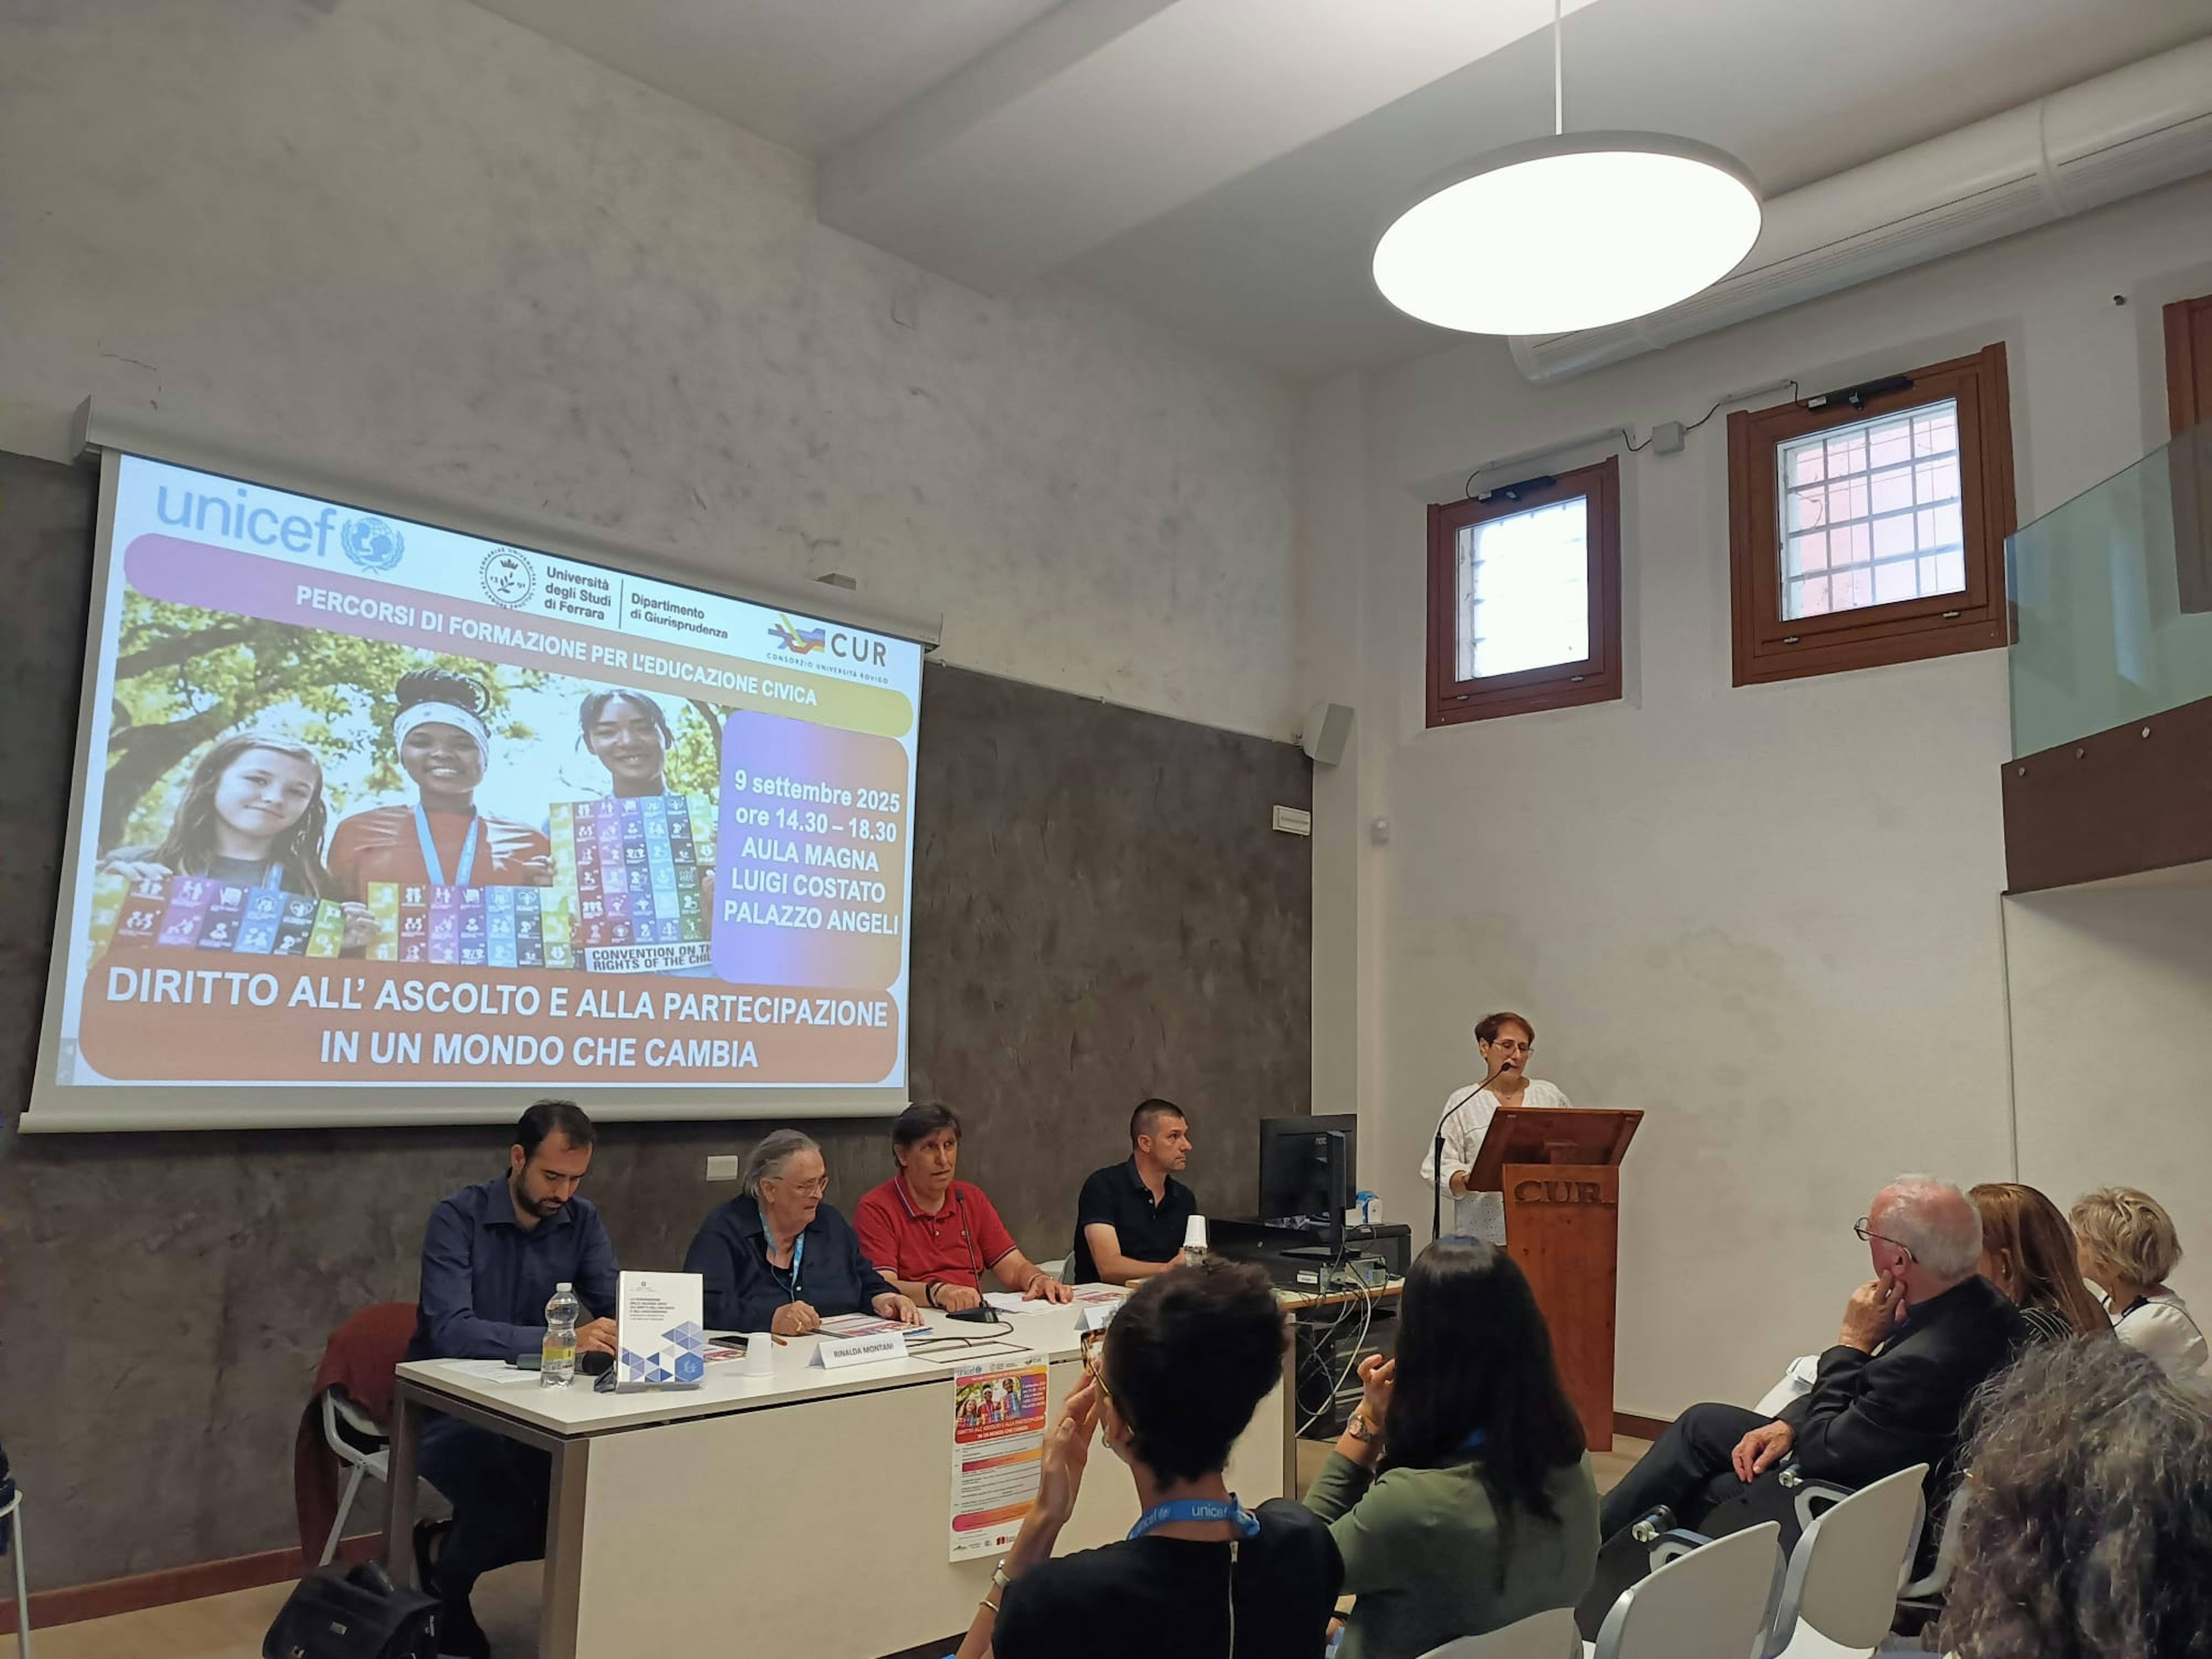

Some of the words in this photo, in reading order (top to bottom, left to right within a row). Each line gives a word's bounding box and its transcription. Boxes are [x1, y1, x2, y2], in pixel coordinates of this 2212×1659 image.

[158, 486, 337, 556] unicef
[547, 566, 609, 591] Università
[545, 583, 576, 600] degli
[579, 590, 612, 607] Studi
[545, 598, 556, 609] di
[559, 600, 605, 620] Ferrara
[631, 593, 705, 619] Dipartimento
[630, 609, 641, 619] di
[644, 611, 728, 639] Giurisprudenza
[296, 585, 414, 627] PERCORSI
[421, 610, 442, 633] DI
[449, 616, 587, 662] FORMAZIONE
[591, 644, 627, 668] PER
[632, 651, 758, 695] L'EDUCAZIONE
[761, 679, 818, 706] CIVICA
[831, 633, 886, 667] CUR
[766, 653, 813, 668] CONSORZIO
[816, 663, 857, 678] UNIVERSITÀ
[860, 672, 888, 684] ROVIGO
[735, 769, 747, 791] 9
[752, 776, 852, 807] settembre
[856, 788, 900, 813] 2025
[736, 807, 770, 826] ore
[776, 807, 828, 834] 14.30
[849, 818, 897, 842] 18.30
[741, 837, 799, 863] AULA
[805, 844, 879, 872] MAGNA
[732, 867, 787, 894] LUIGI
[793, 874, 886, 903] COSTATO
[724, 900, 822, 929] PALAZZO
[827, 910, 899, 935] ANGELI
[592, 947, 676, 960] CONVENTION
[679, 946, 695, 956] ON
[594, 958, 640, 971] RIGHTS
[644, 958, 660, 967] OF
[661, 955, 685, 965] THE
[107, 967, 279, 1007] DIRITTO
[288, 976, 366, 1010] ALL'
[374, 979, 540, 1016] ASCOLTO
[549, 988, 569, 1016] E
[576, 990, 655, 1020] ALLA
[663, 992, 888, 1027] PARTECIPAZIONE
[320, 1030, 359, 1063] IN
[371, 1032, 422, 1064] UN
[433, 1034, 564, 1066] MONDO
[573, 1036, 637, 1067] CHE
[644, 1038, 759, 1068] CAMBIA
[1514, 1180, 1601, 1203] CUR
[834, 1348, 862, 1357] RINALDA
[863, 1343, 894, 1354] MONTANI
[1192, 1504, 1228, 1517] unicef
